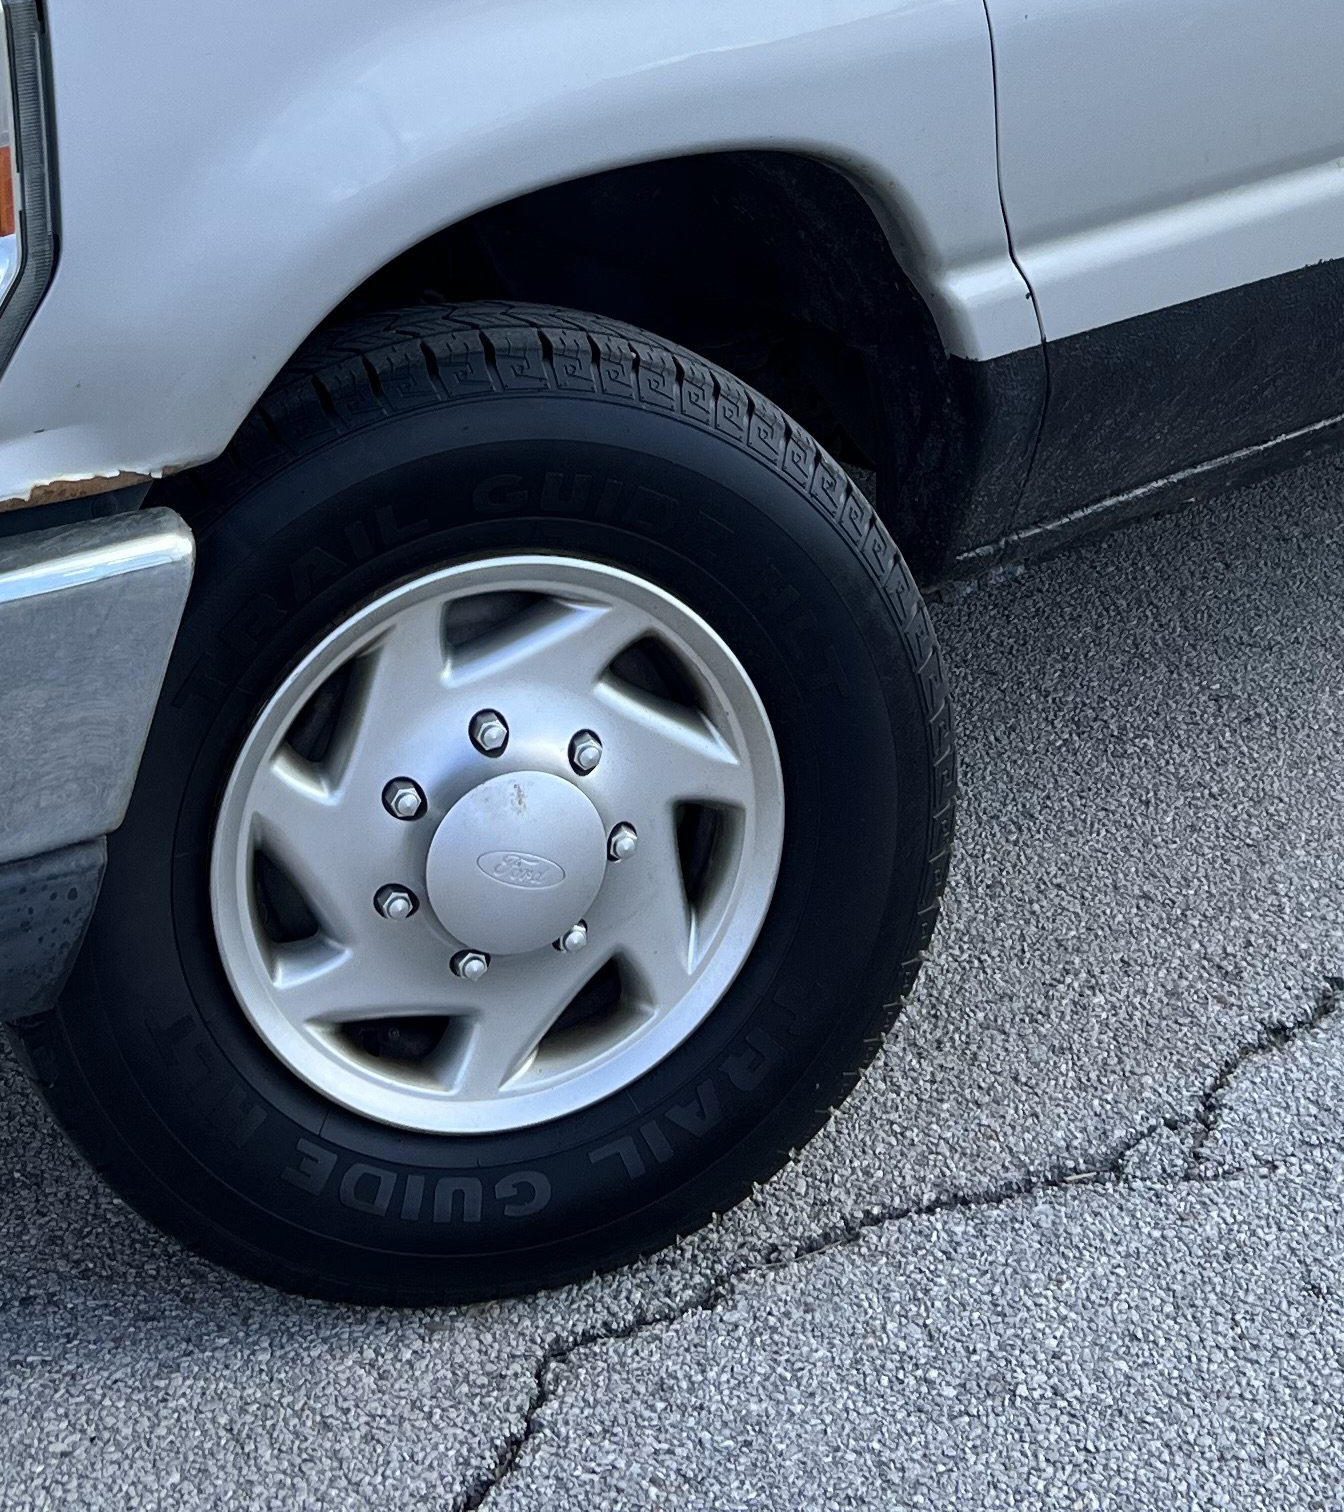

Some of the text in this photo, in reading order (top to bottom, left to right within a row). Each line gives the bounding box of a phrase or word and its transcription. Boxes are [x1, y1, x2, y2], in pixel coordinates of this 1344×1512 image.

[171, 504, 431, 710] TRAIL
[471, 471, 735, 559] GUIDE
[279, 1137, 554, 1224] GUIDE
[587, 983, 816, 1181] TRAIL
